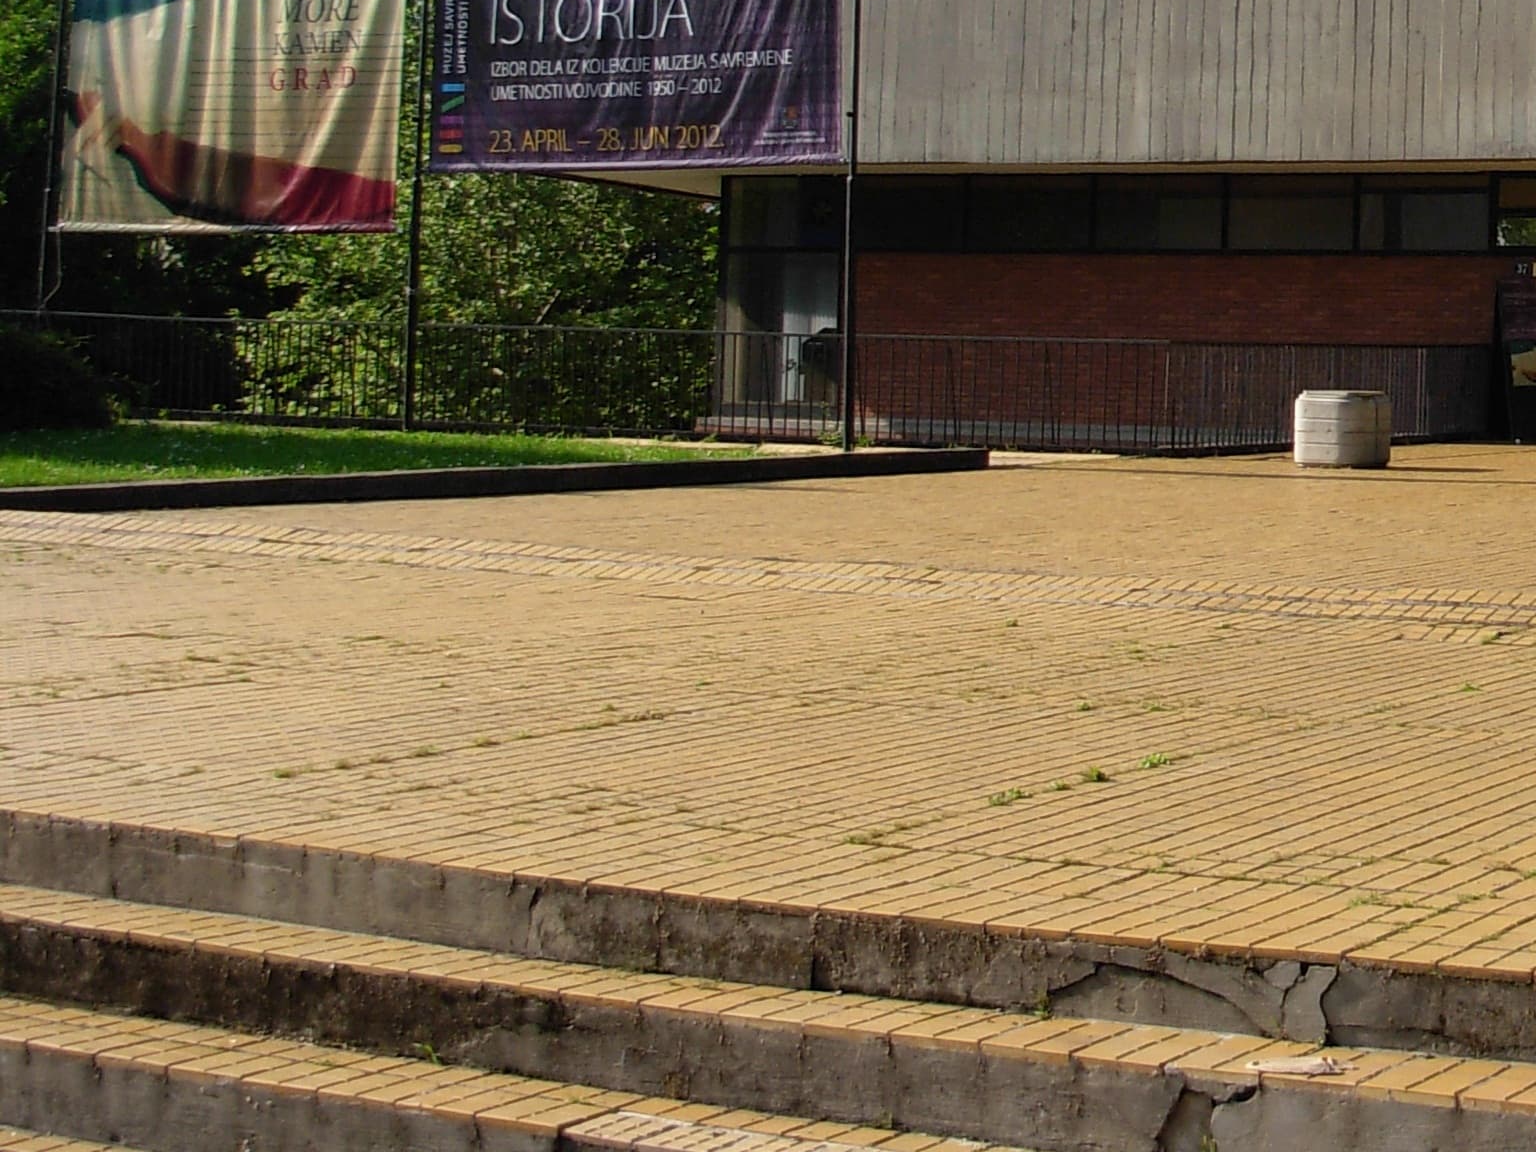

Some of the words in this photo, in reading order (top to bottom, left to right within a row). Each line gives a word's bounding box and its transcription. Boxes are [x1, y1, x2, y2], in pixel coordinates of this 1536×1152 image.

[273, 29, 363, 56] KAMEN
[456, 1, 469, 74] UMETNOSTI
[442, 33, 454, 74] MUZEJ
[490, 61, 527, 77] IZBOR
[530, 59, 563, 76] DELA
[566, 58, 579, 75] IZ
[582, 56, 651, 74] KOLEKCIJE
[654, 53, 707, 71] MUZEJA
[710, 49, 793, 70] SAVREMENE
[269, 66, 357, 92] GRAD
[490, 83, 562, 101] UMETNOSTI
[564, 81, 643, 99] VOJVODINE
[647, 80, 675, 97] 1950
[691, 78, 722, 95] 2012
[489, 130, 516, 153] 23.
[520, 129, 573, 152] APRIL
[596, 127, 625, 151] 28.
[630, 126, 669, 151] JUN
[675, 125, 725, 149] 2012.
